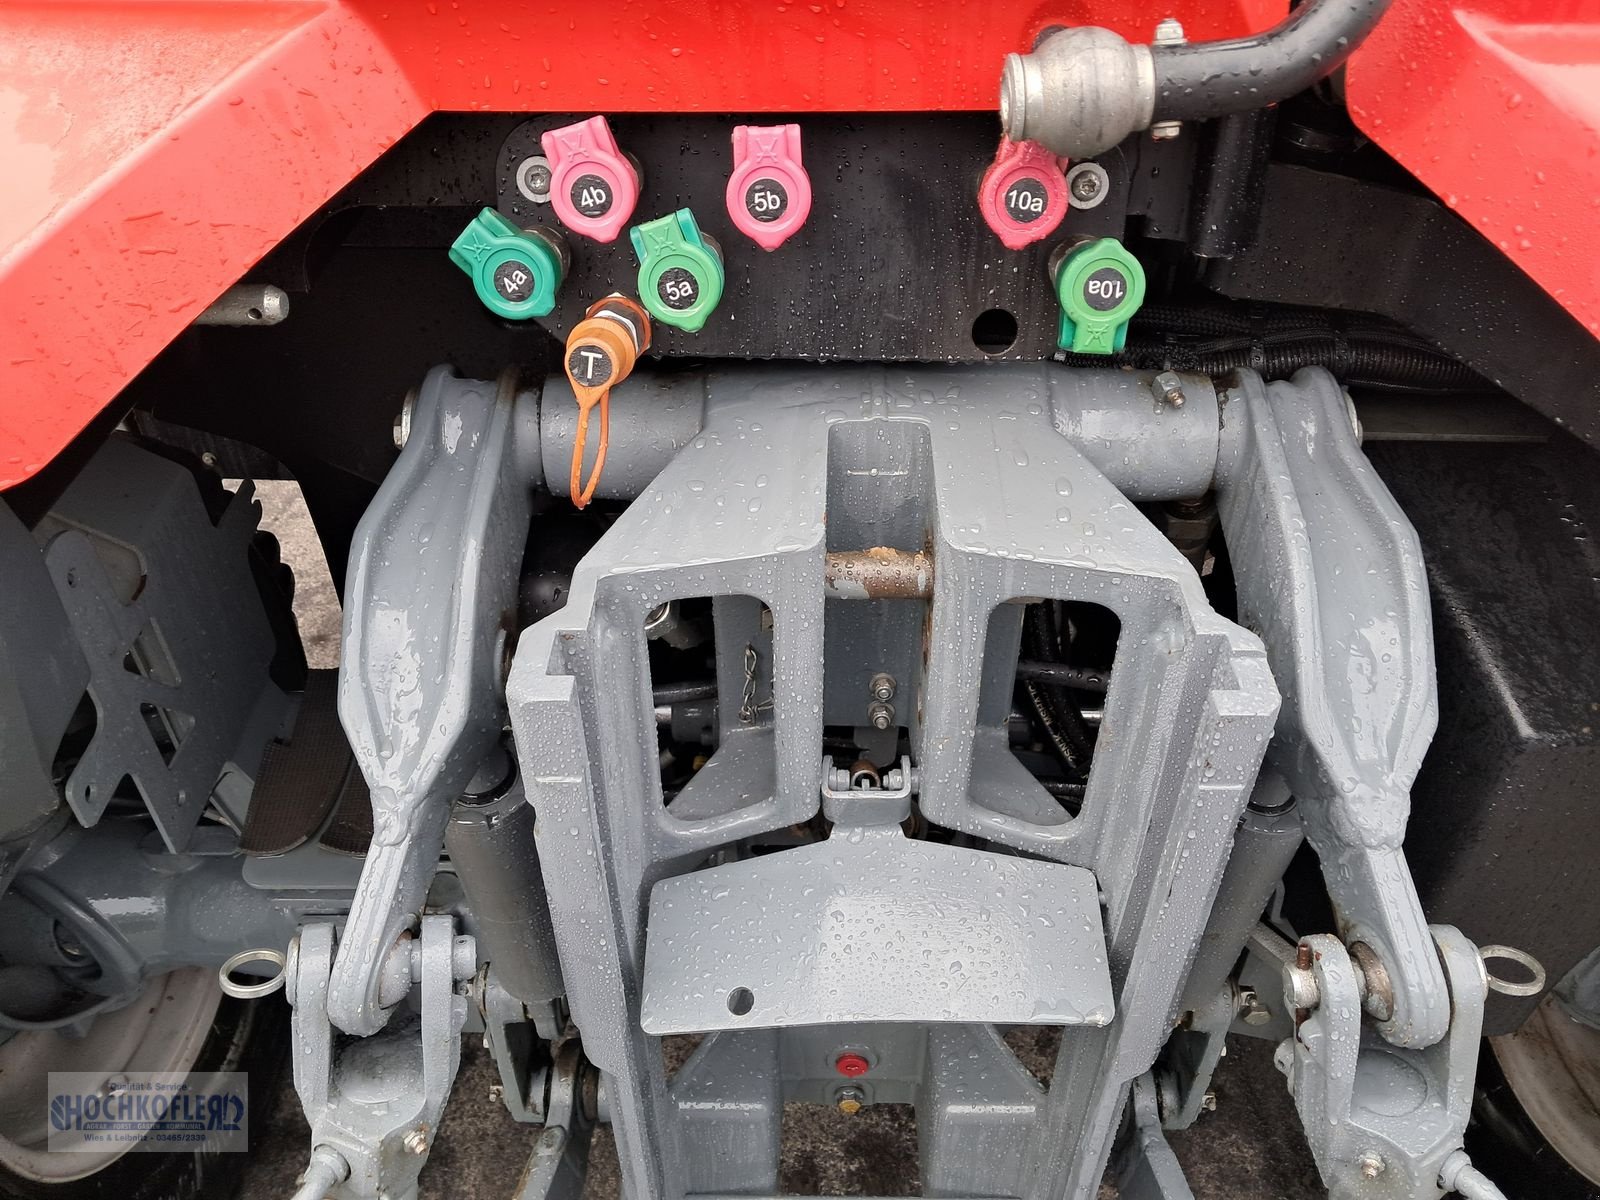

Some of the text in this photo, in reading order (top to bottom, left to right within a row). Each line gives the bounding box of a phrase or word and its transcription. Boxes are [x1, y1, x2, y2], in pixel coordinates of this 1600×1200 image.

[581, 186, 607, 207] 4b
[755, 191, 781, 212] 5b
[1009, 190, 1044, 213] 10a
[504, 270, 528, 294] 4a
[666, 281, 694, 301] 5a
[1088, 280, 1124, 299] 10a
[580, 351, 603, 379] T
